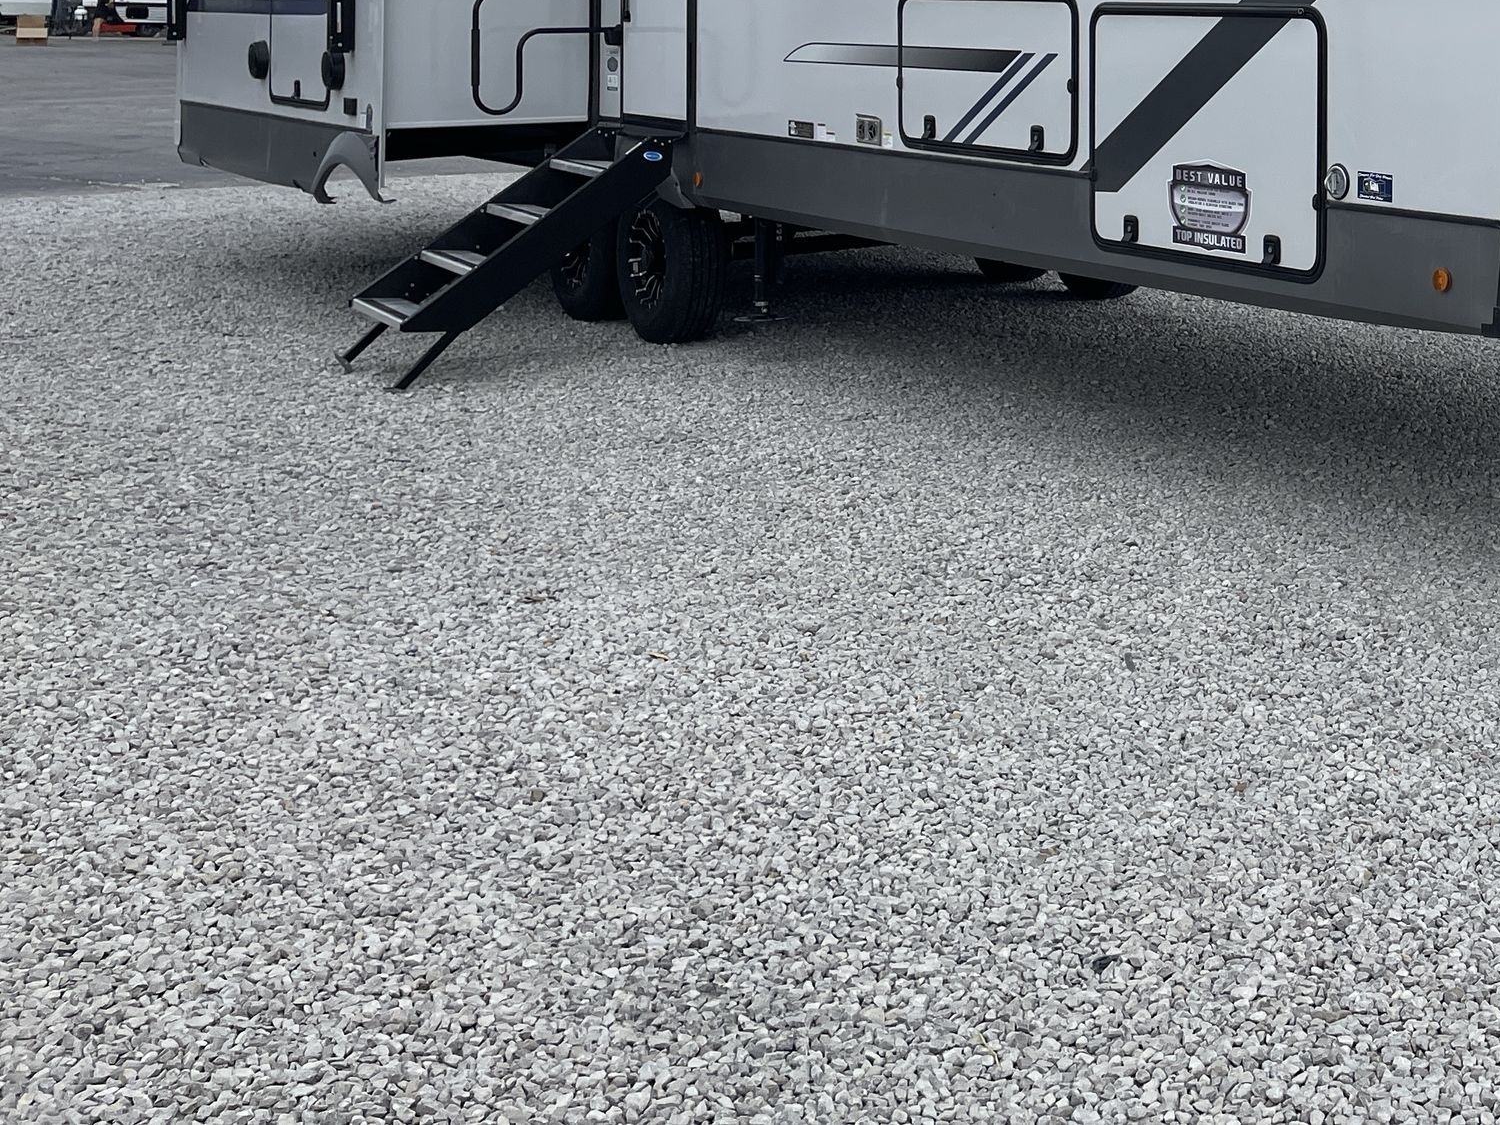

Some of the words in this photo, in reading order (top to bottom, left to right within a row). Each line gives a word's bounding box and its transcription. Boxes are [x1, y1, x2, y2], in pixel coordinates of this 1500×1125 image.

[1175, 169, 1202, 183] BEST
[1207, 172, 1243, 188] VALUE
[1175, 229, 1193, 242] TOP
[1194, 232, 1243, 250] INSULATED
